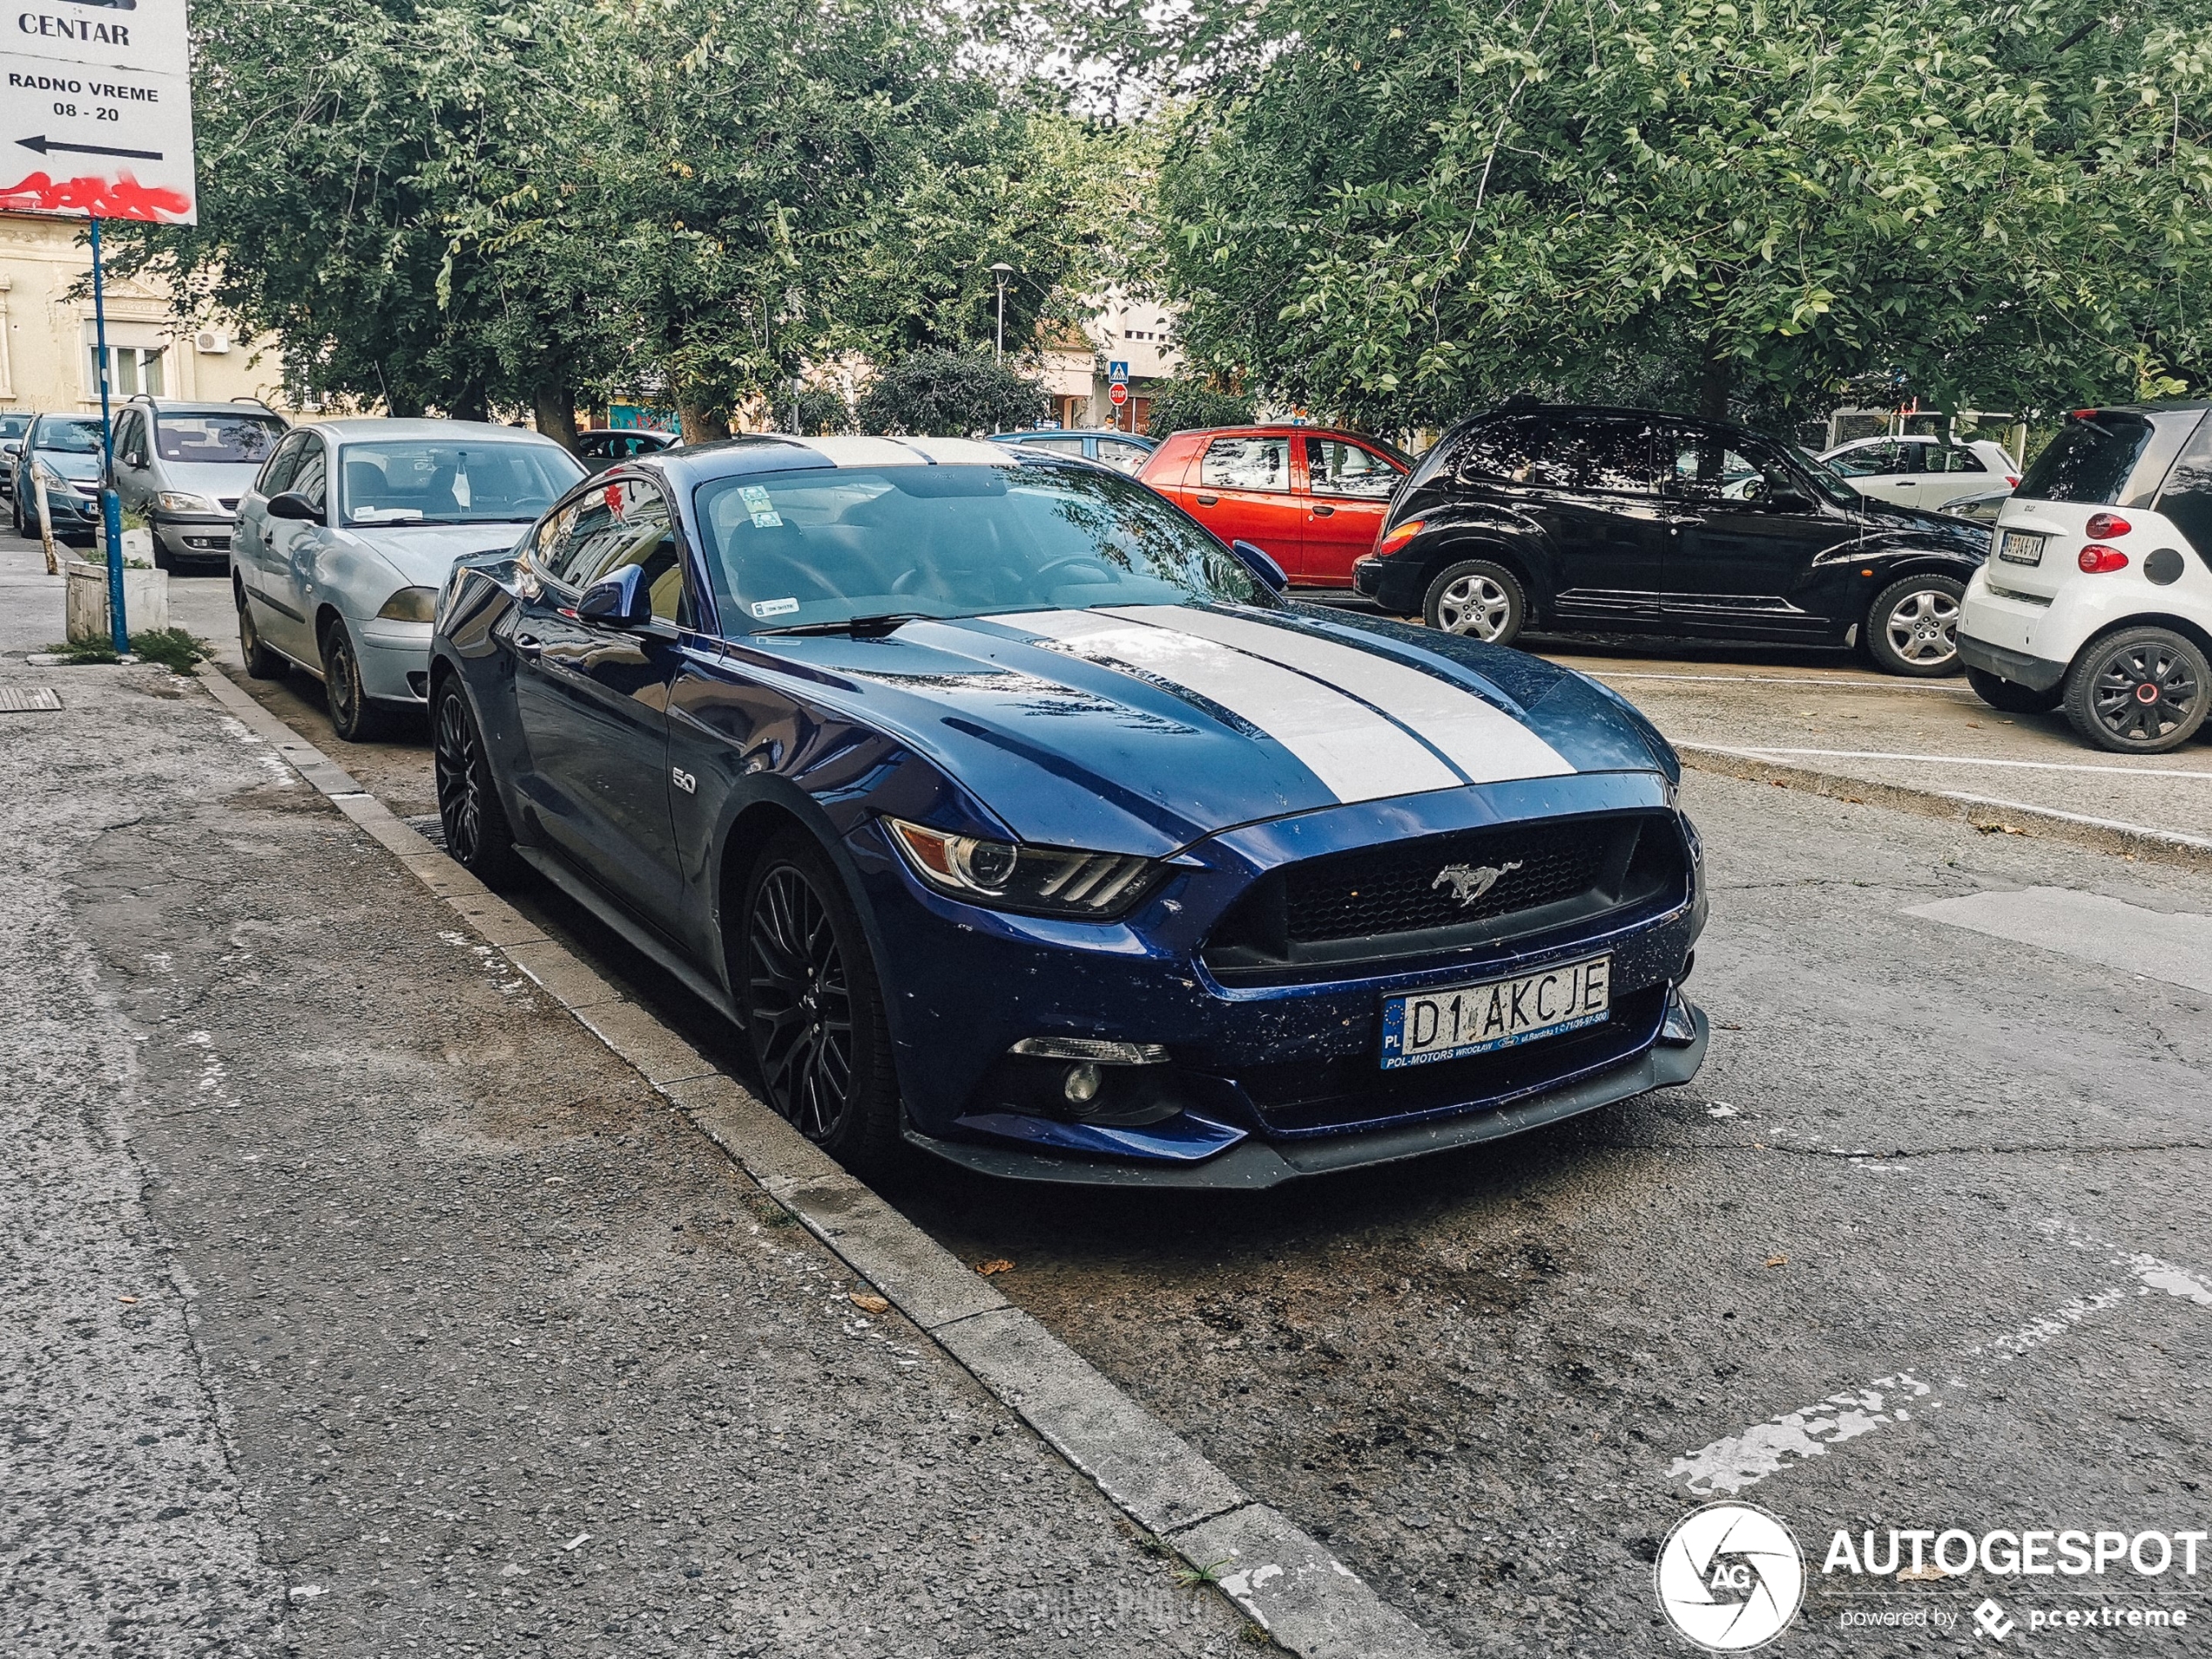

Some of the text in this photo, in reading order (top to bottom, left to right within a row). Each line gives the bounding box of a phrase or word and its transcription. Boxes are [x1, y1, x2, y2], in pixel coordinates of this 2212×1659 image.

[18, 13, 130, 46] CENTAR
[9, 73, 158, 102] RADNO VREME
[53, 103, 77, 117] 08
[97, 107, 119, 122] 20
[1413, 961, 1605, 1049] D1 AKCJE
[1385, 1035, 1400, 1049] PL
[1386, 1049, 1453, 1069] POL-MOTORS
